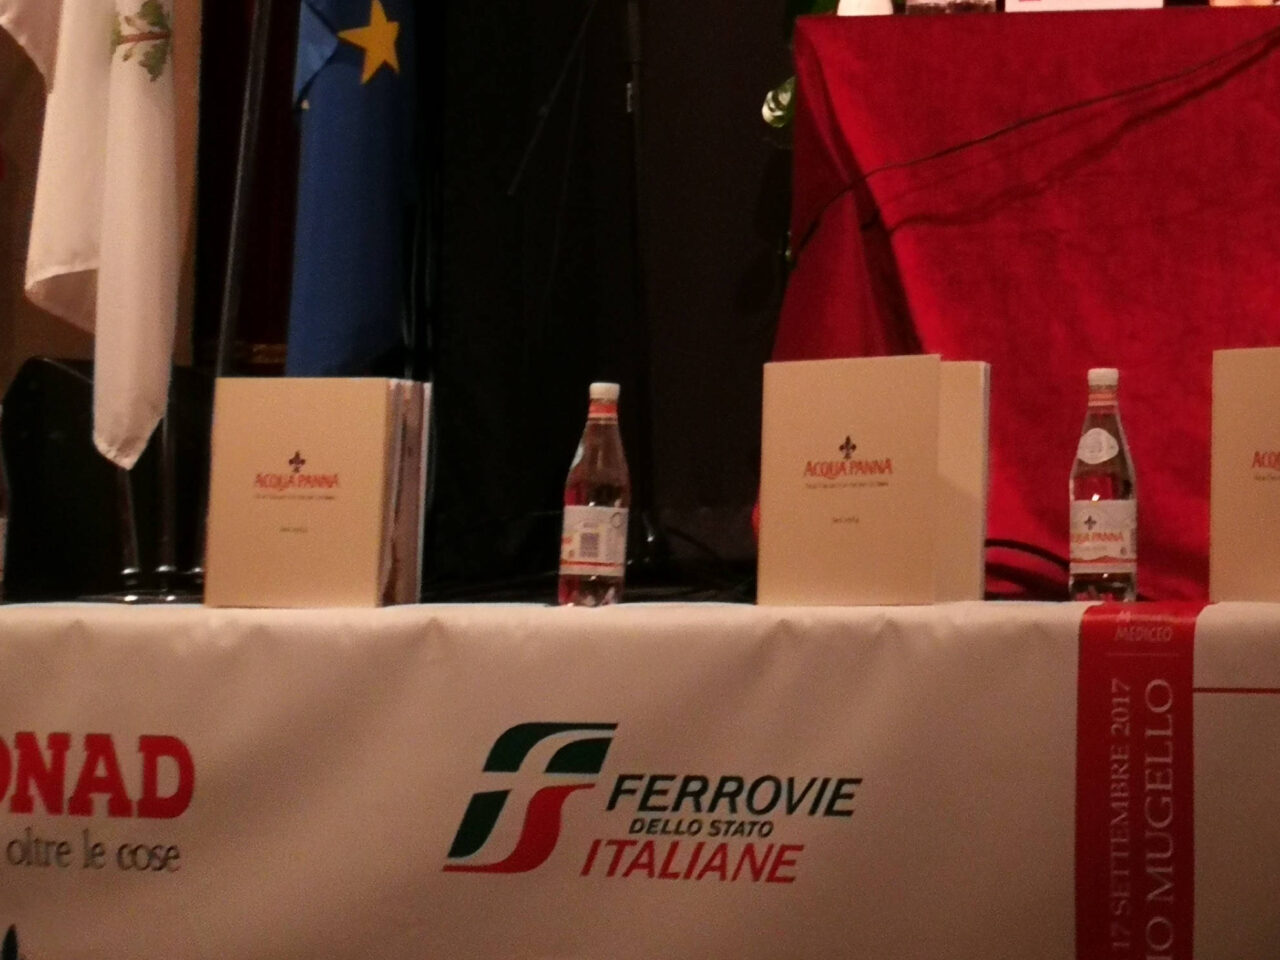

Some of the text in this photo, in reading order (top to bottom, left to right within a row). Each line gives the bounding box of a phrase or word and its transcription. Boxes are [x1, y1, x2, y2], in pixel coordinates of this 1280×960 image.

[803, 457, 893, 479] ACQUA PANNA
[1110, 678, 1131, 736] 2017
[0, 731, 196, 820] NAD
[606, 774, 863, 817] FERROVIE
[1143, 678, 1174, 904] MUGELLO
[6, 826, 181, 873] oltre le cose
[628, 818, 774, 839] DELLO STATO
[579, 838, 804, 884] ITALIANE
